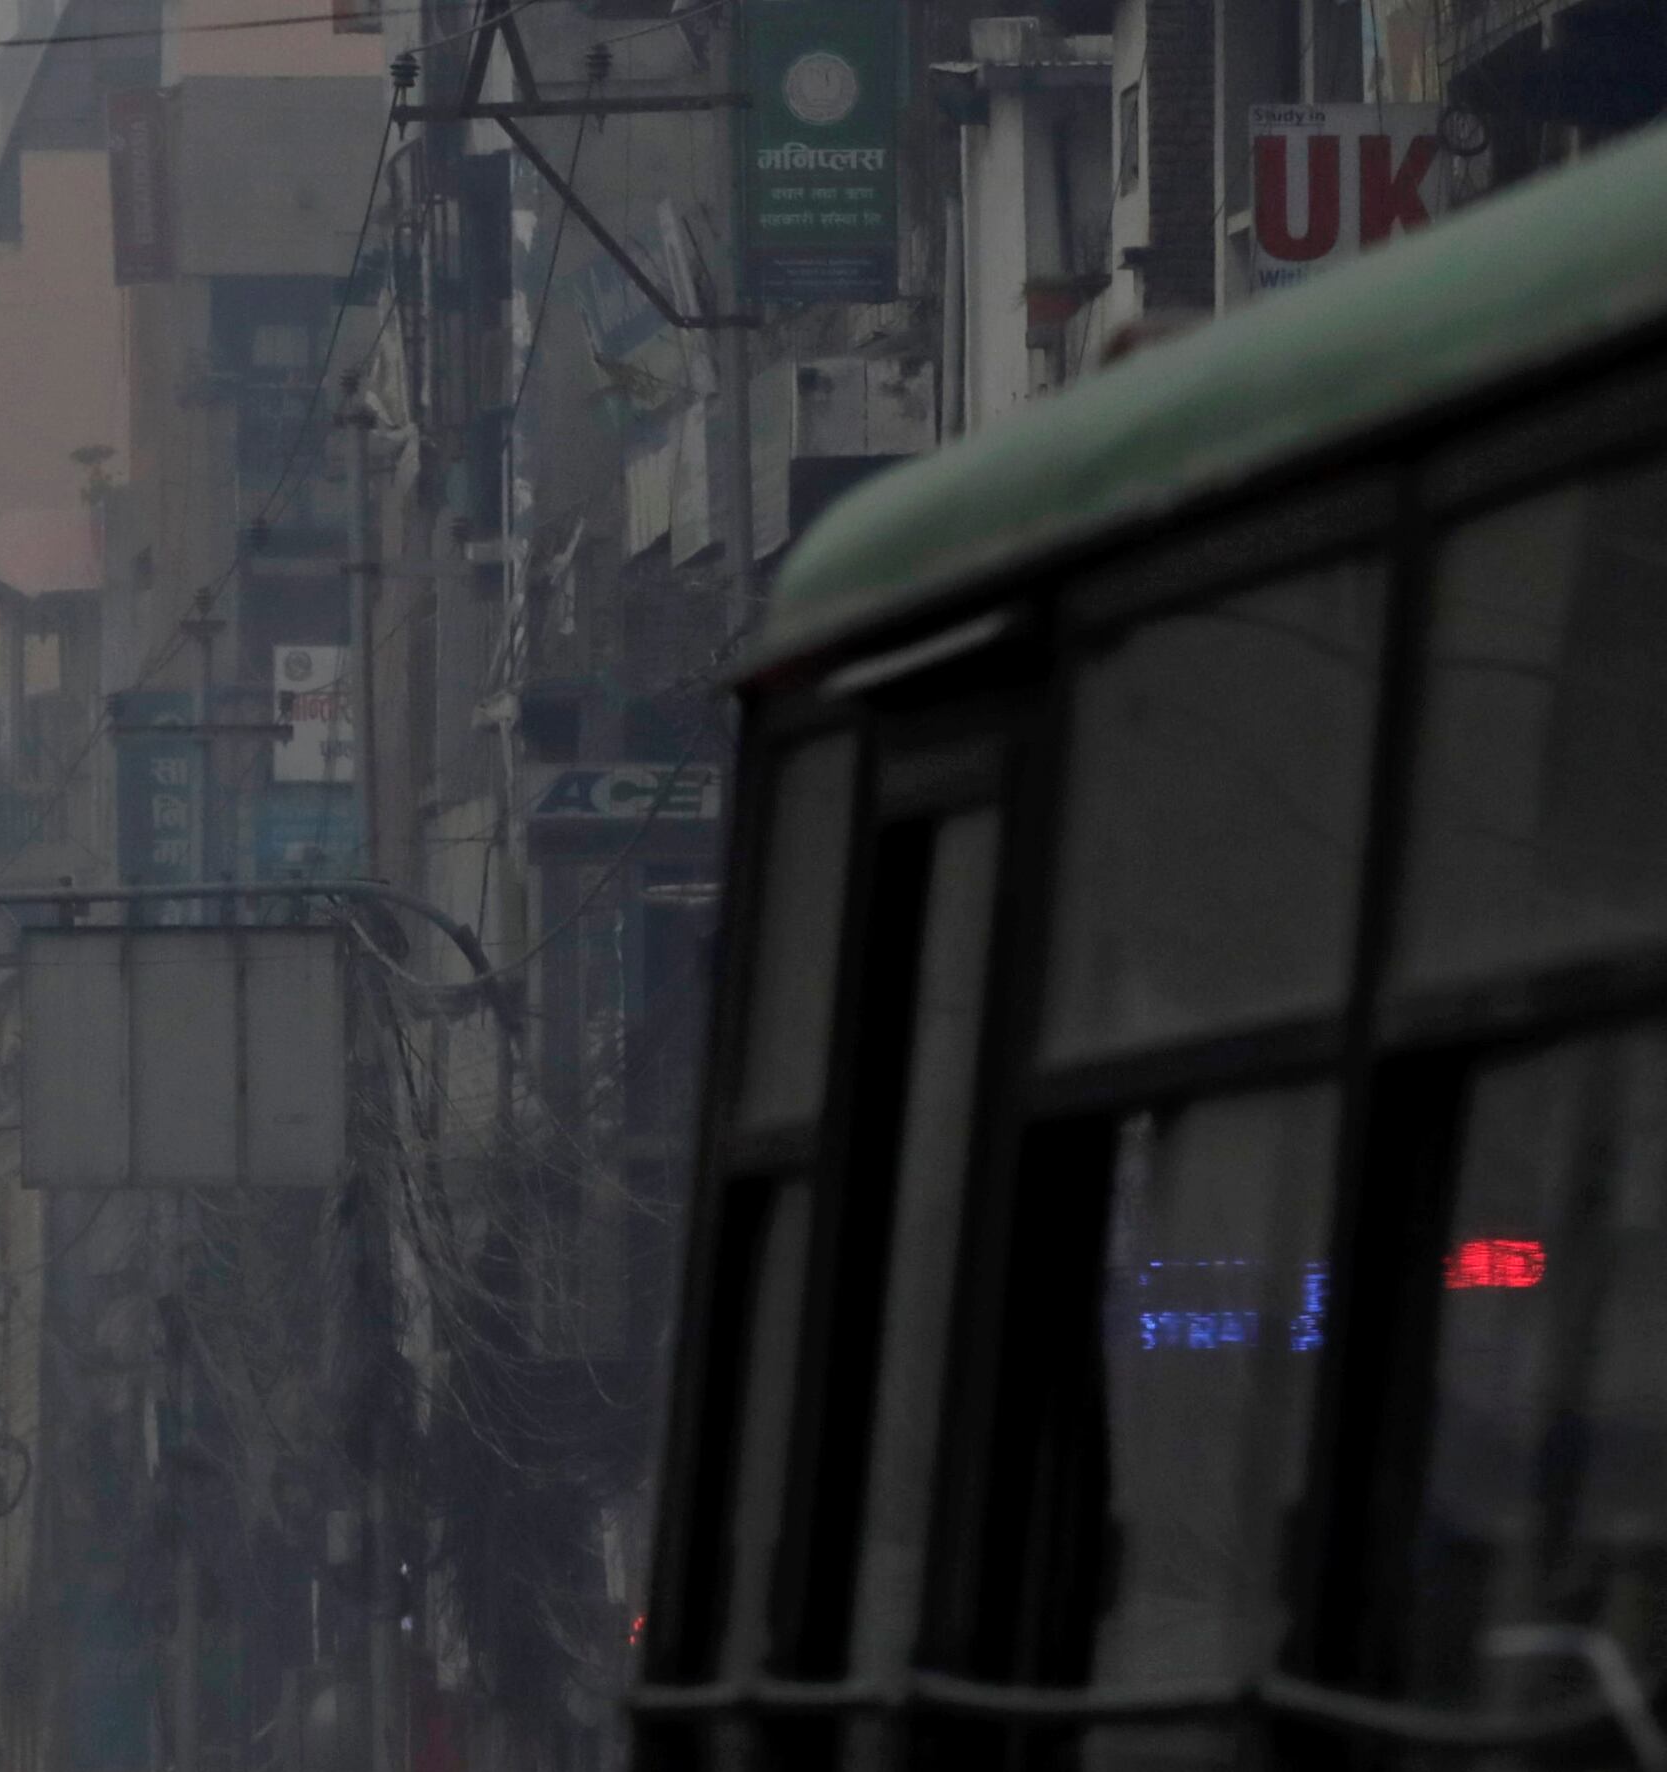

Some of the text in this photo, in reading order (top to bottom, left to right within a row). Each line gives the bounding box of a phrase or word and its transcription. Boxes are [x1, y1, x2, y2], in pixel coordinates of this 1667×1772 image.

[1254, 108, 1326, 126] Study in
[1253, 134, 1439, 261] UK
[535, 771, 709, 813] ACE
